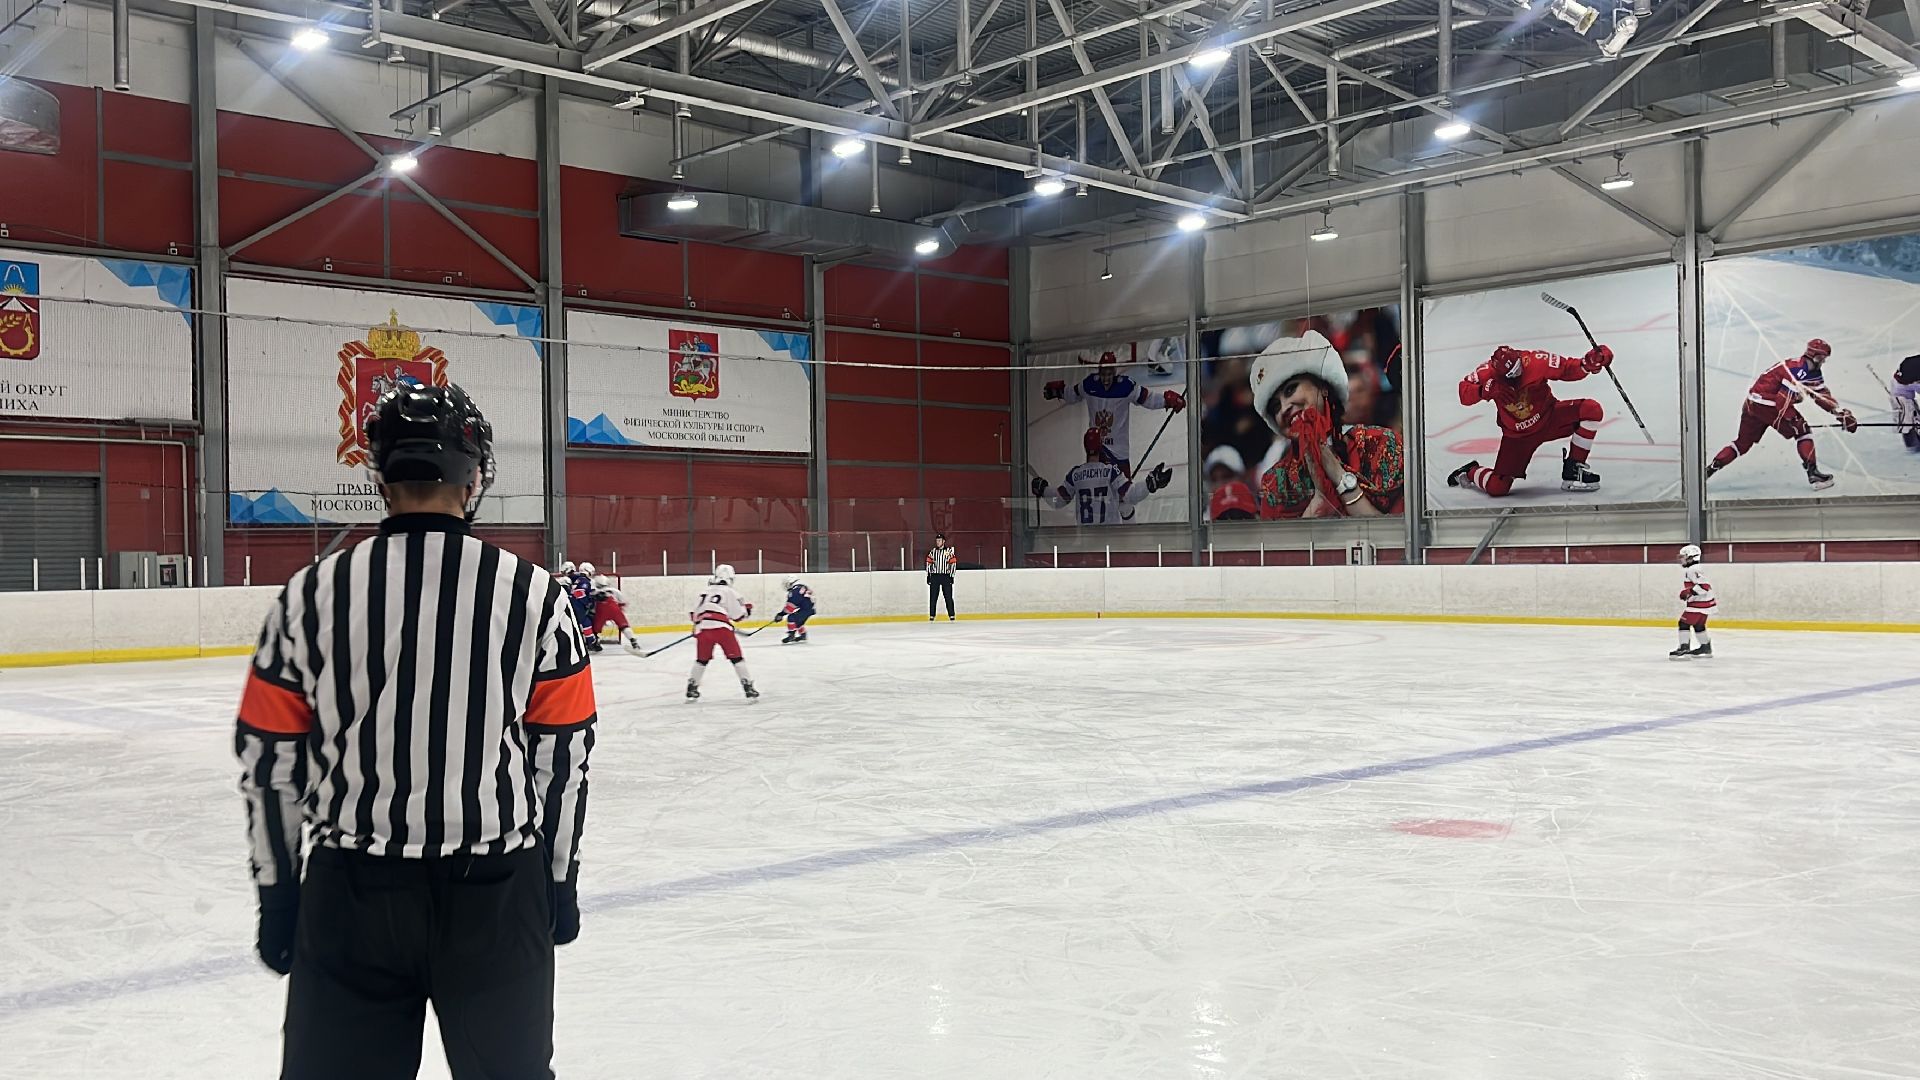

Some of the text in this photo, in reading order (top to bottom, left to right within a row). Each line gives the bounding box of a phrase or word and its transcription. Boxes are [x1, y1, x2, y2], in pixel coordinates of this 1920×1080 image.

[15, 384, 68, 397] ОКРУГ
[662, 408, 730, 420] МИНИСТЕРСТВО
[623, 417, 765, 433] ФИЗИЧЕСКОЙ КУЛЬТУРЫ И СПОРТА
[1515, 412, 1541, 431] РОССИЯ
[648, 431, 745, 443] МОСКОВСКОЙ ОБЛАСТИ
[1078, 486, 1109, 524] 87
